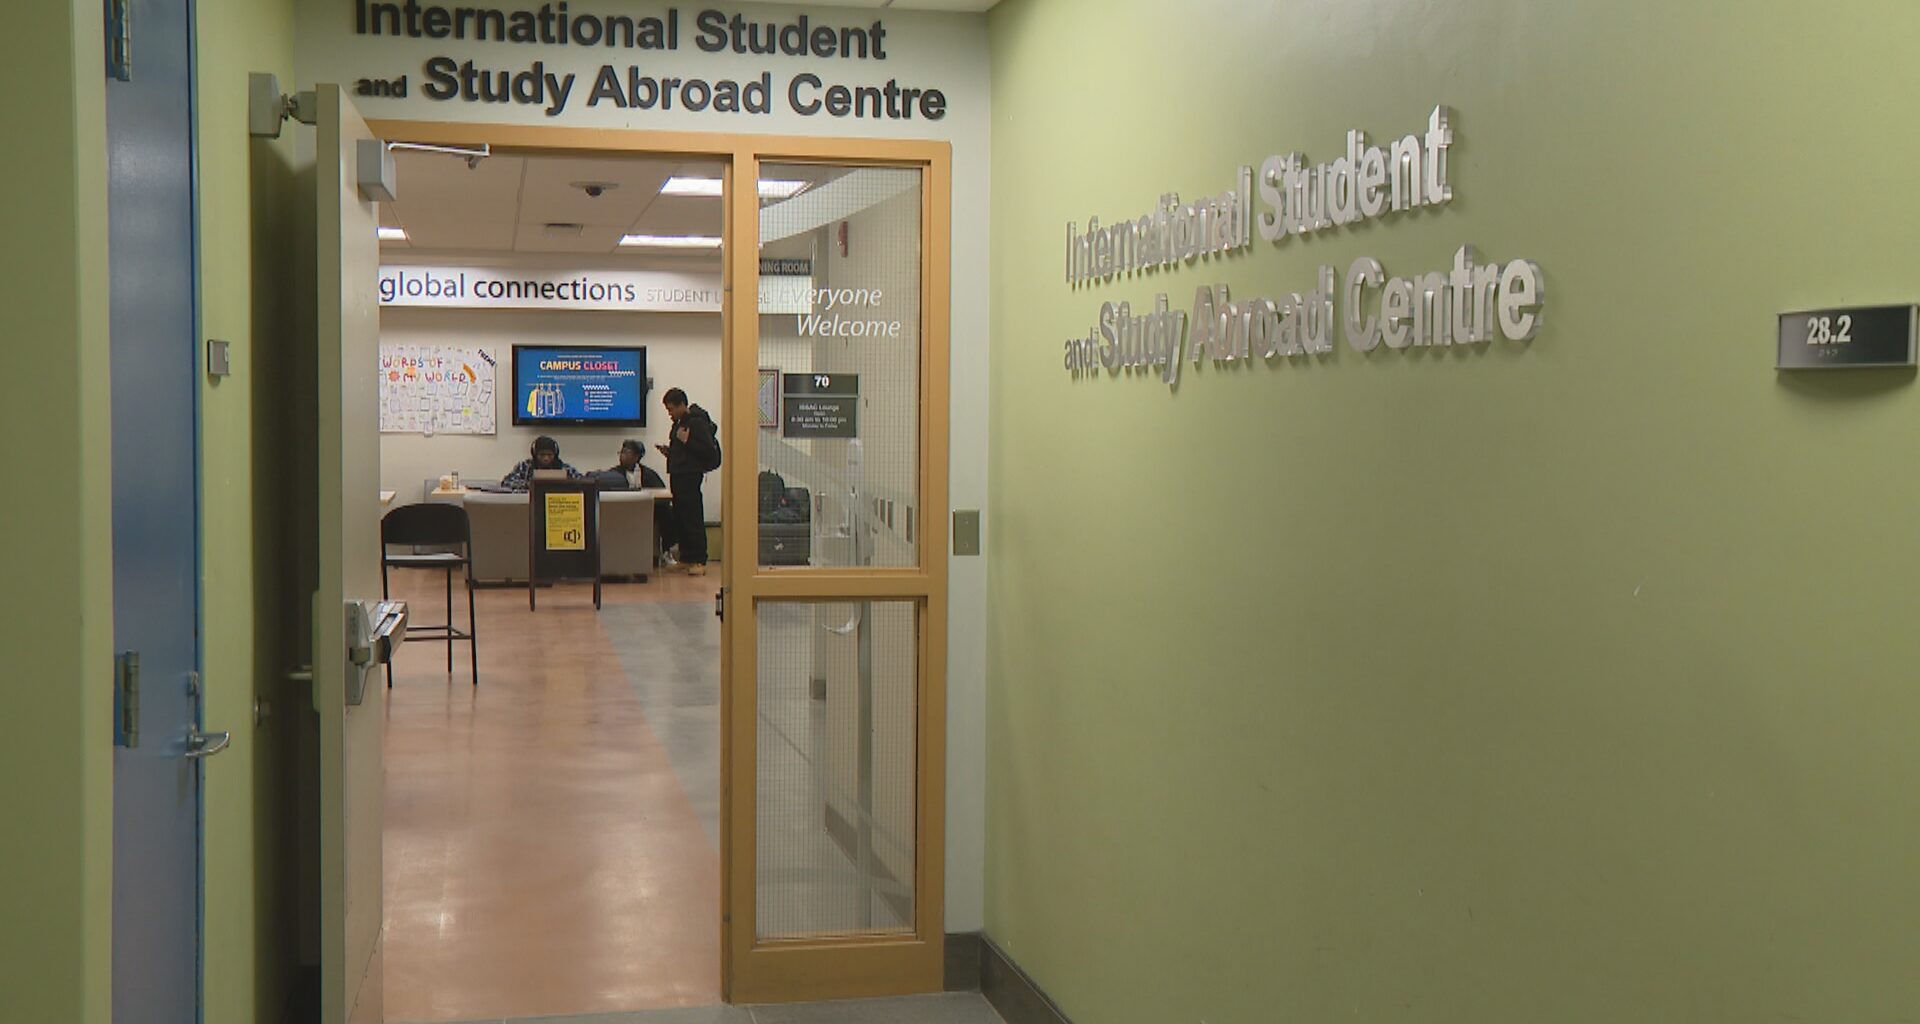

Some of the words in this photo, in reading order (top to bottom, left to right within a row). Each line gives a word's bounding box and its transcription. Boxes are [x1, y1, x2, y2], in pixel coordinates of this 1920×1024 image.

[355, 0, 678, 50] International
[695, 9, 887, 60] Student
[356, 75, 408, 98] and
[424, 57, 576, 117] Study
[586, 65, 771, 113] Abroad
[788, 73, 946, 121] Centre
[1066, 165, 1252, 286] International
[1257, 104, 1453, 242] Student
[782, 261, 809, 273] ROOM
[379, 272, 465, 303] global
[473, 277, 637, 302] connections
[647, 288, 711, 303] STUDENT
[779, 287, 883, 311] Everyone
[797, 313, 902, 337] Welcome
[1064, 326, 1099, 372] and
[1100, 292, 1186, 385] Study
[1187, 265, 1335, 363] Abroad
[1344, 244, 1545, 353] Centre
[1806, 315, 1852, 345] 28.2
[540, 360, 581, 371] CAMPUS
[583, 360, 619, 371] CLOSET
[814, 375, 830, 388] 70
